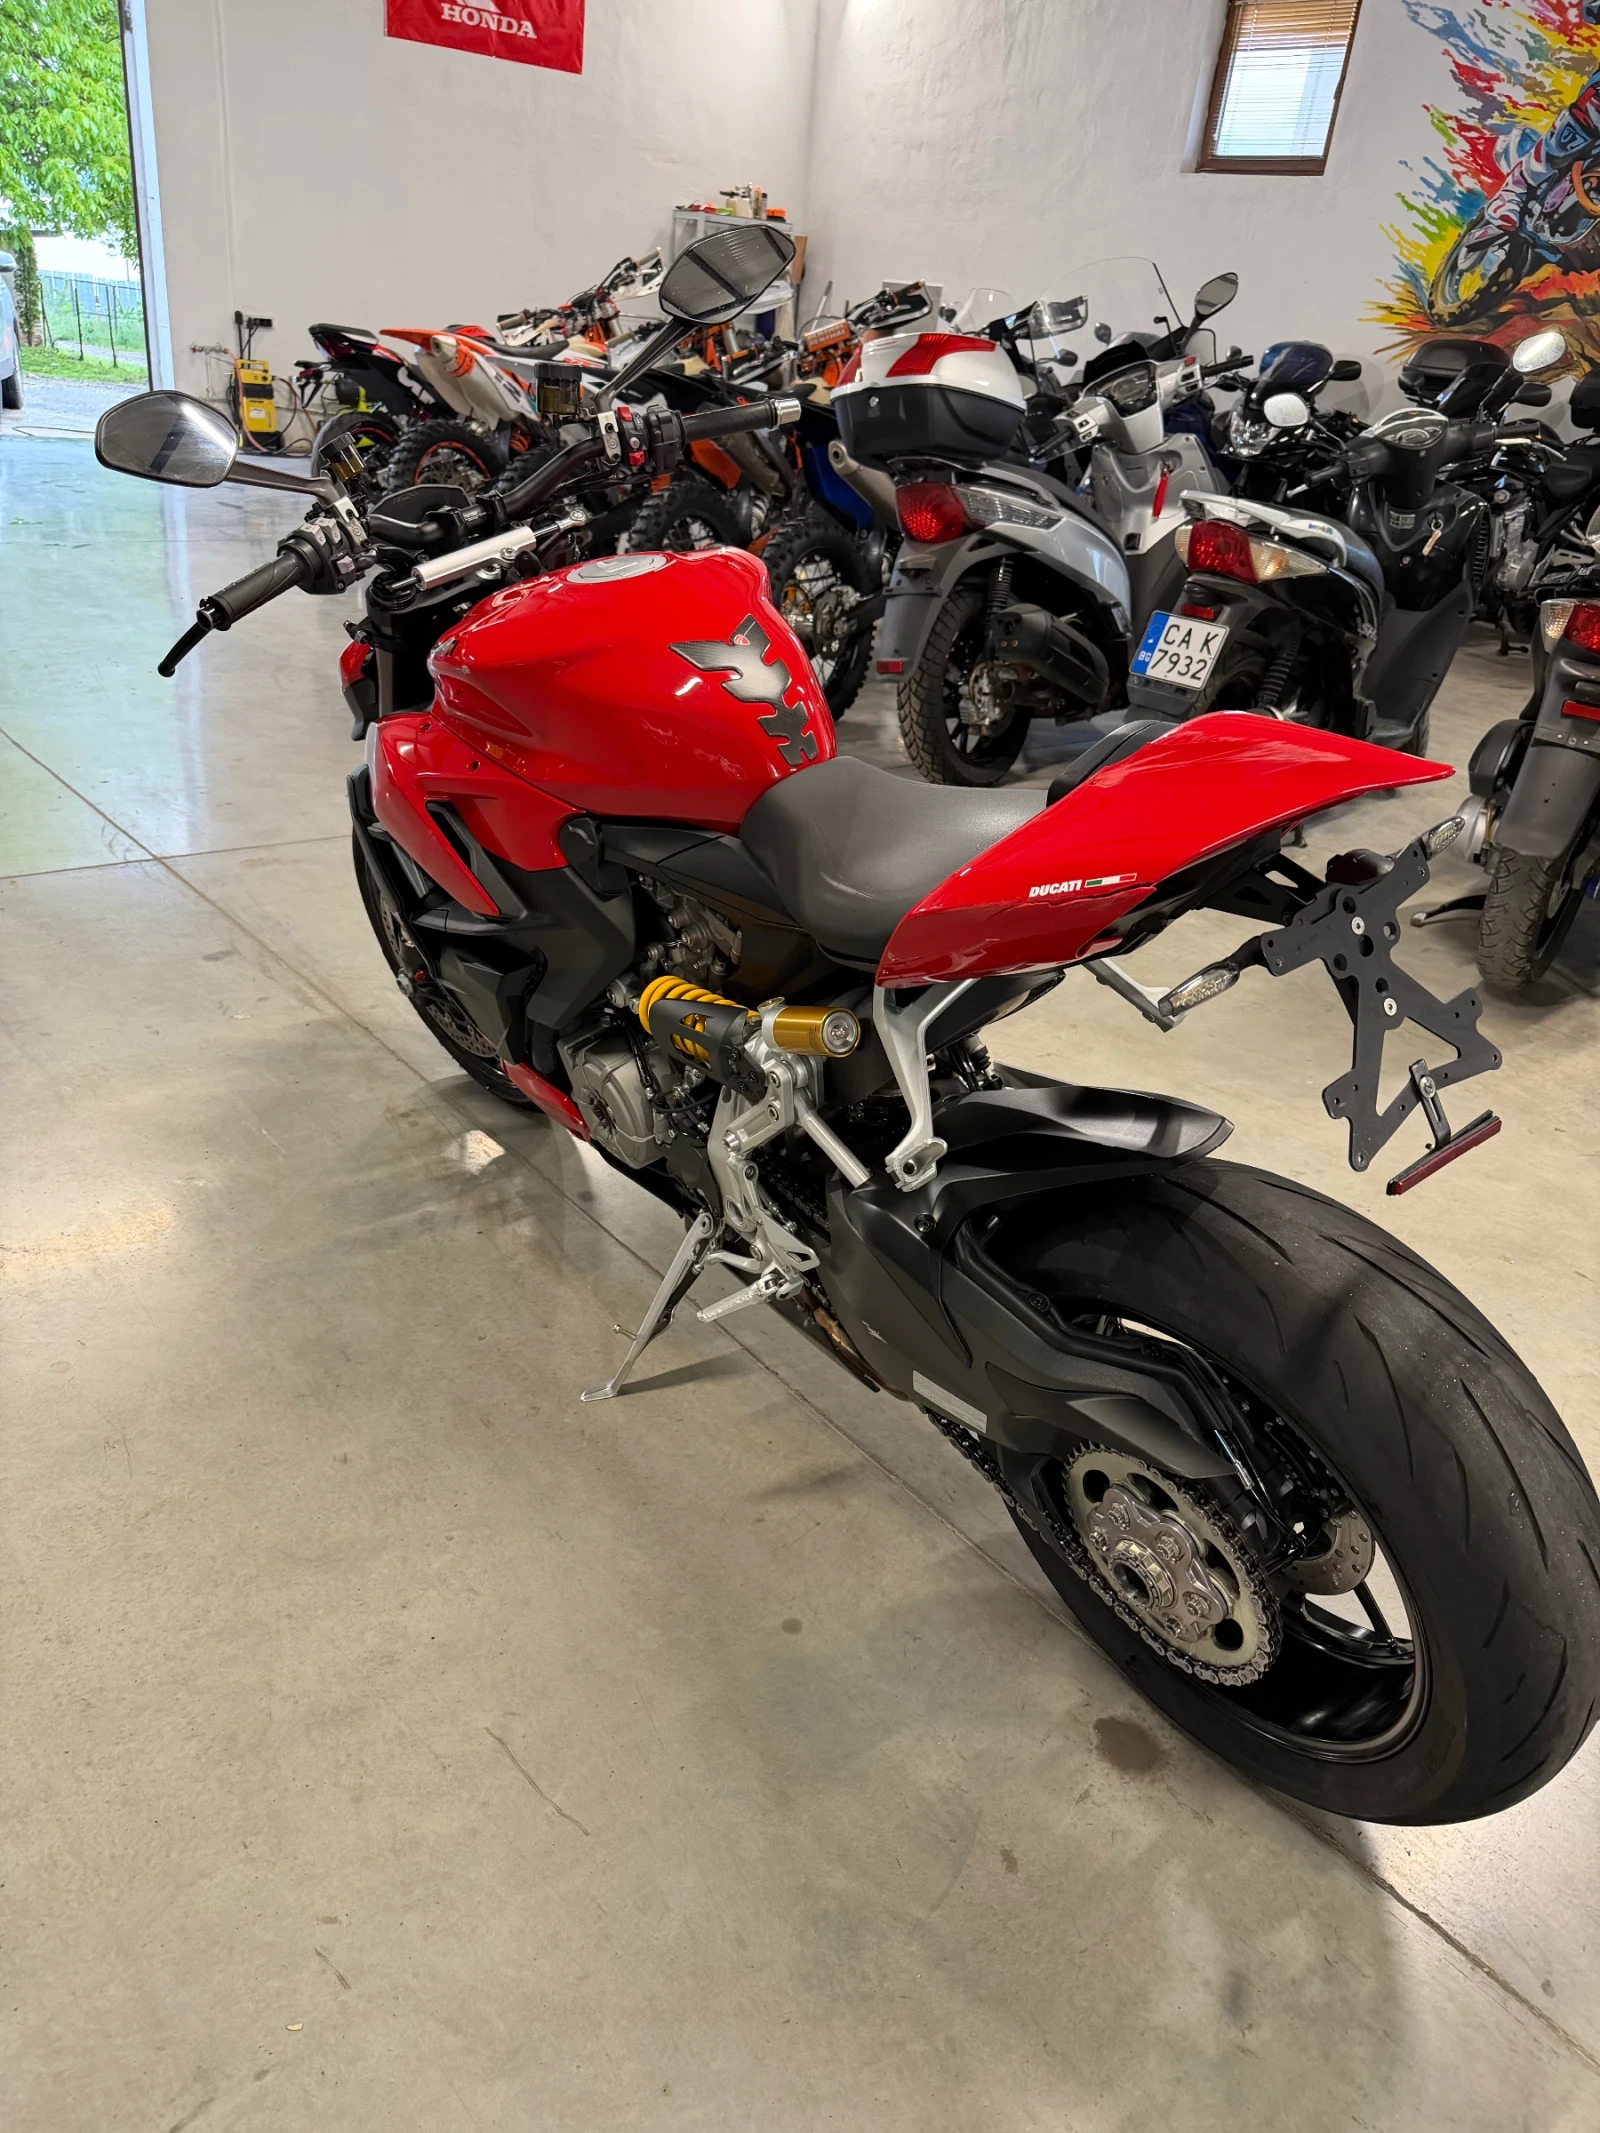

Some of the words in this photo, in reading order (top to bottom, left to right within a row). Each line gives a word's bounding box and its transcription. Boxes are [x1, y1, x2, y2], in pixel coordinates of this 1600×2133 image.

[441, 3, 537, 39] HONDA
[1163, 624, 1193, 650] CA
[1200, 631, 1220, 656] K
[1137, 650, 1152, 663] BG
[1150, 648, 1208, 681] 7932
[1028, 879, 1083, 898] DUCATI
